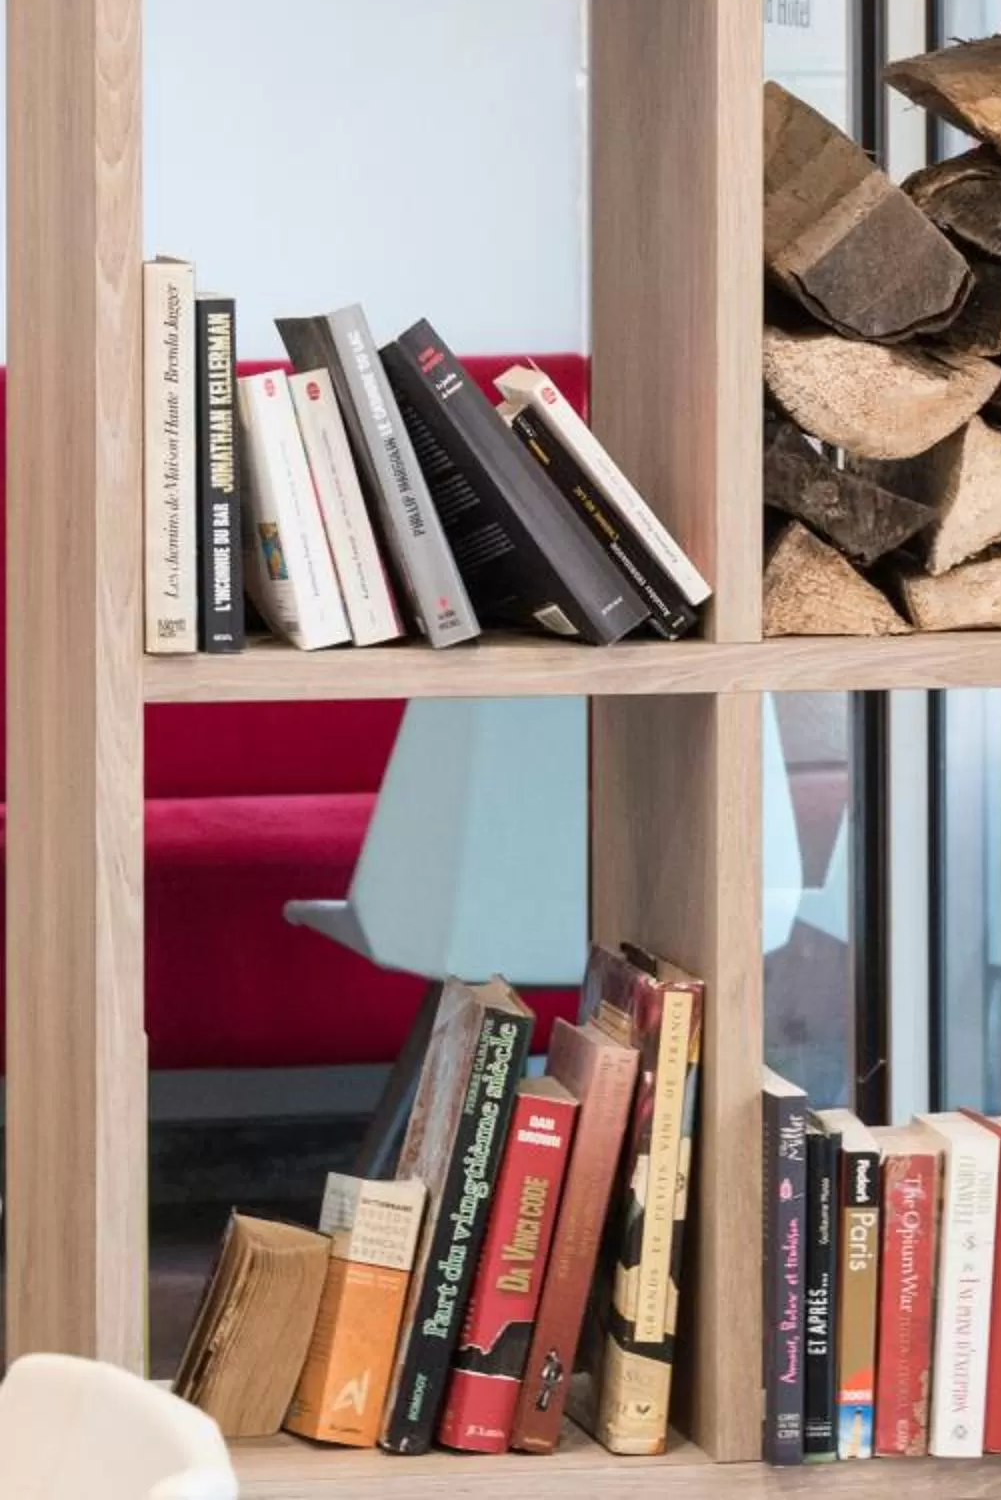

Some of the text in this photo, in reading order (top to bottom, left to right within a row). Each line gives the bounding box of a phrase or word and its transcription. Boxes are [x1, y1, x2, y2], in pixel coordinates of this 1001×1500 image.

[163, 283, 182, 329] Jagger
[163, 333, 179, 383] Brenda
[206, 312, 231, 404] KELLERMAN
[162, 391, 179, 435] Haute
[162, 439, 179, 489] Maison
[208, 409, 233, 492] JONATHAN
[163, 493, 178, 511] de
[211, 503, 230, 526] BAR
[212, 529, 229, 544] DU
[666, 999, 685, 1064] FRANCE
[478, 1019, 521, 1099] siècle
[528, 1114, 556, 1130] DAN
[777, 1113, 806, 1160] Miller
[443, 1099, 512, 1244] vingtième
[898, 1172, 928, 1209] The
[514, 1172, 554, 1220] CODE
[434, 1240, 469, 1282] du
[848, 1211, 875, 1271] Paris
[893, 1209, 924, 1275] Opium
[783, 1272, 799, 1285] et
[896, 1274, 919, 1313] War
[808, 1339, 828, 1355] ET
